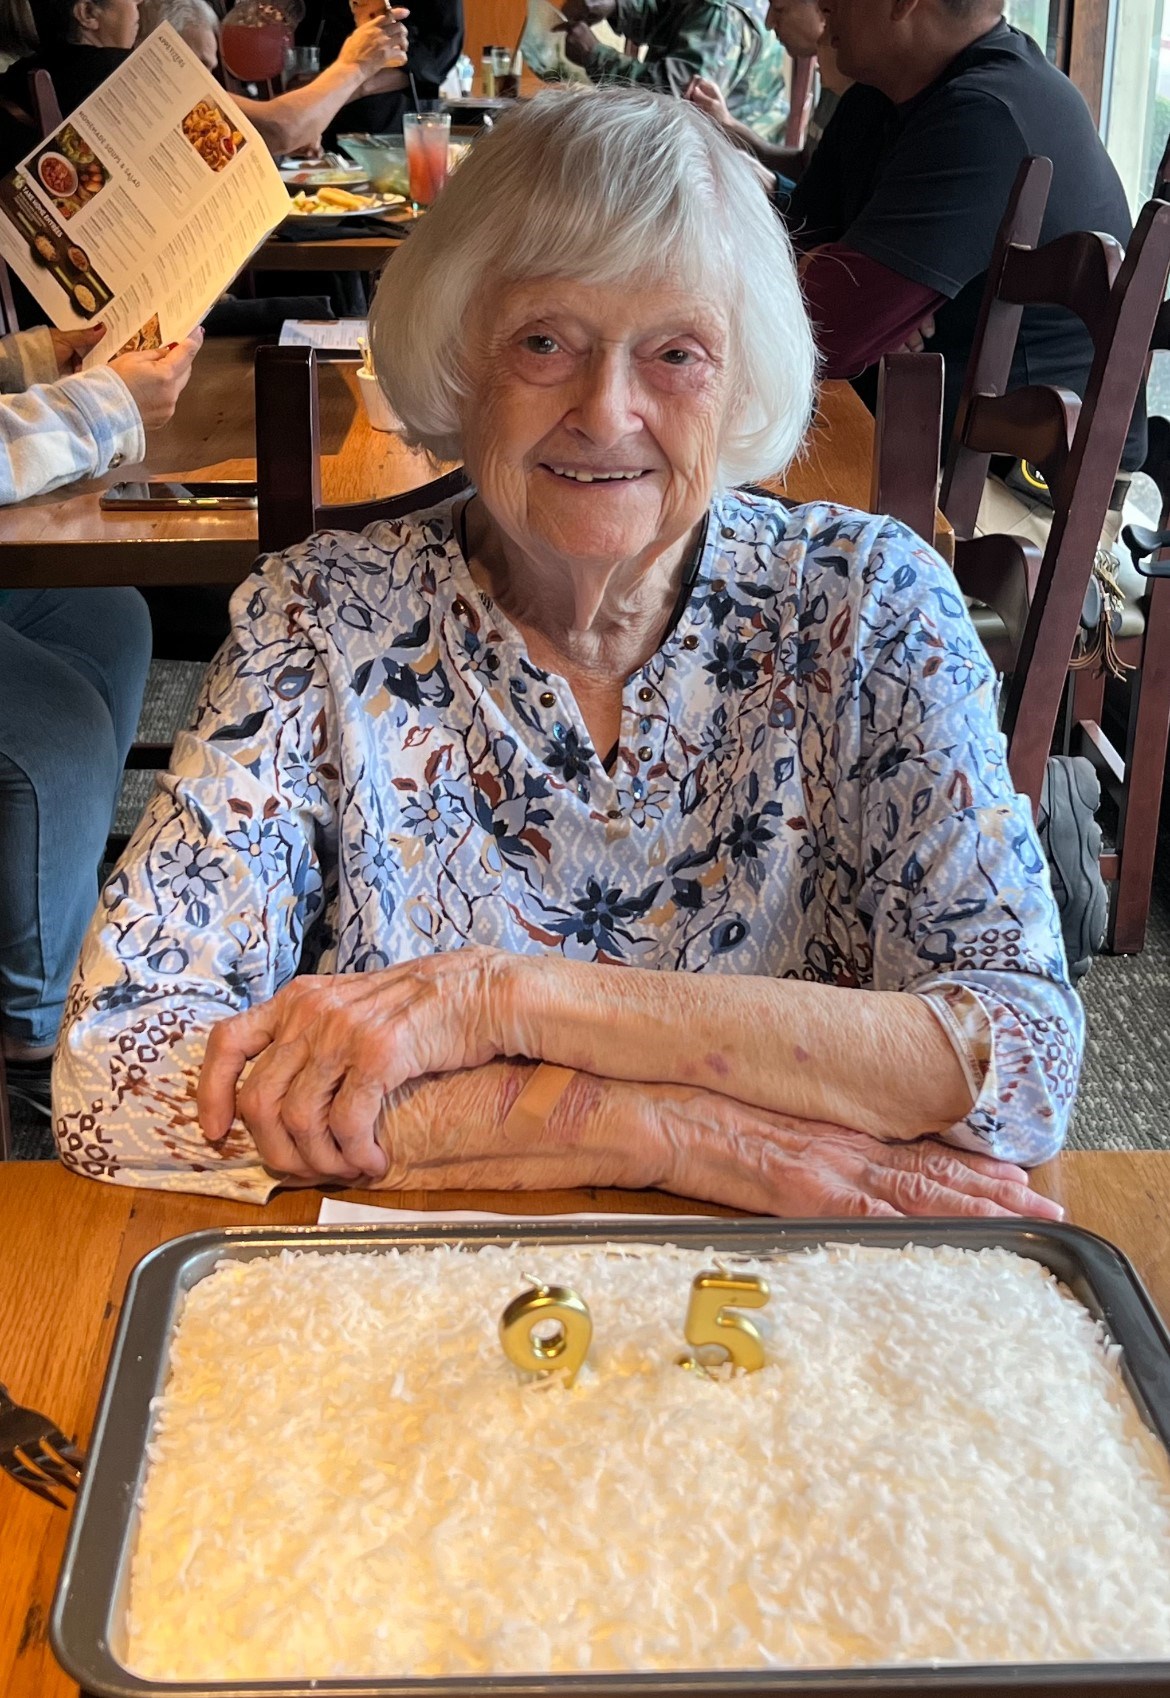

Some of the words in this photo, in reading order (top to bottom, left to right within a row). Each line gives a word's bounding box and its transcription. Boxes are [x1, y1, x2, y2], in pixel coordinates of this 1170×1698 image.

[158, 36, 186, 68] APPETIZERS
[79, 110, 106, 144] HOMEMADE
[105, 143, 121, 164] SOUPS
[124, 168, 140, 188] SALAD
